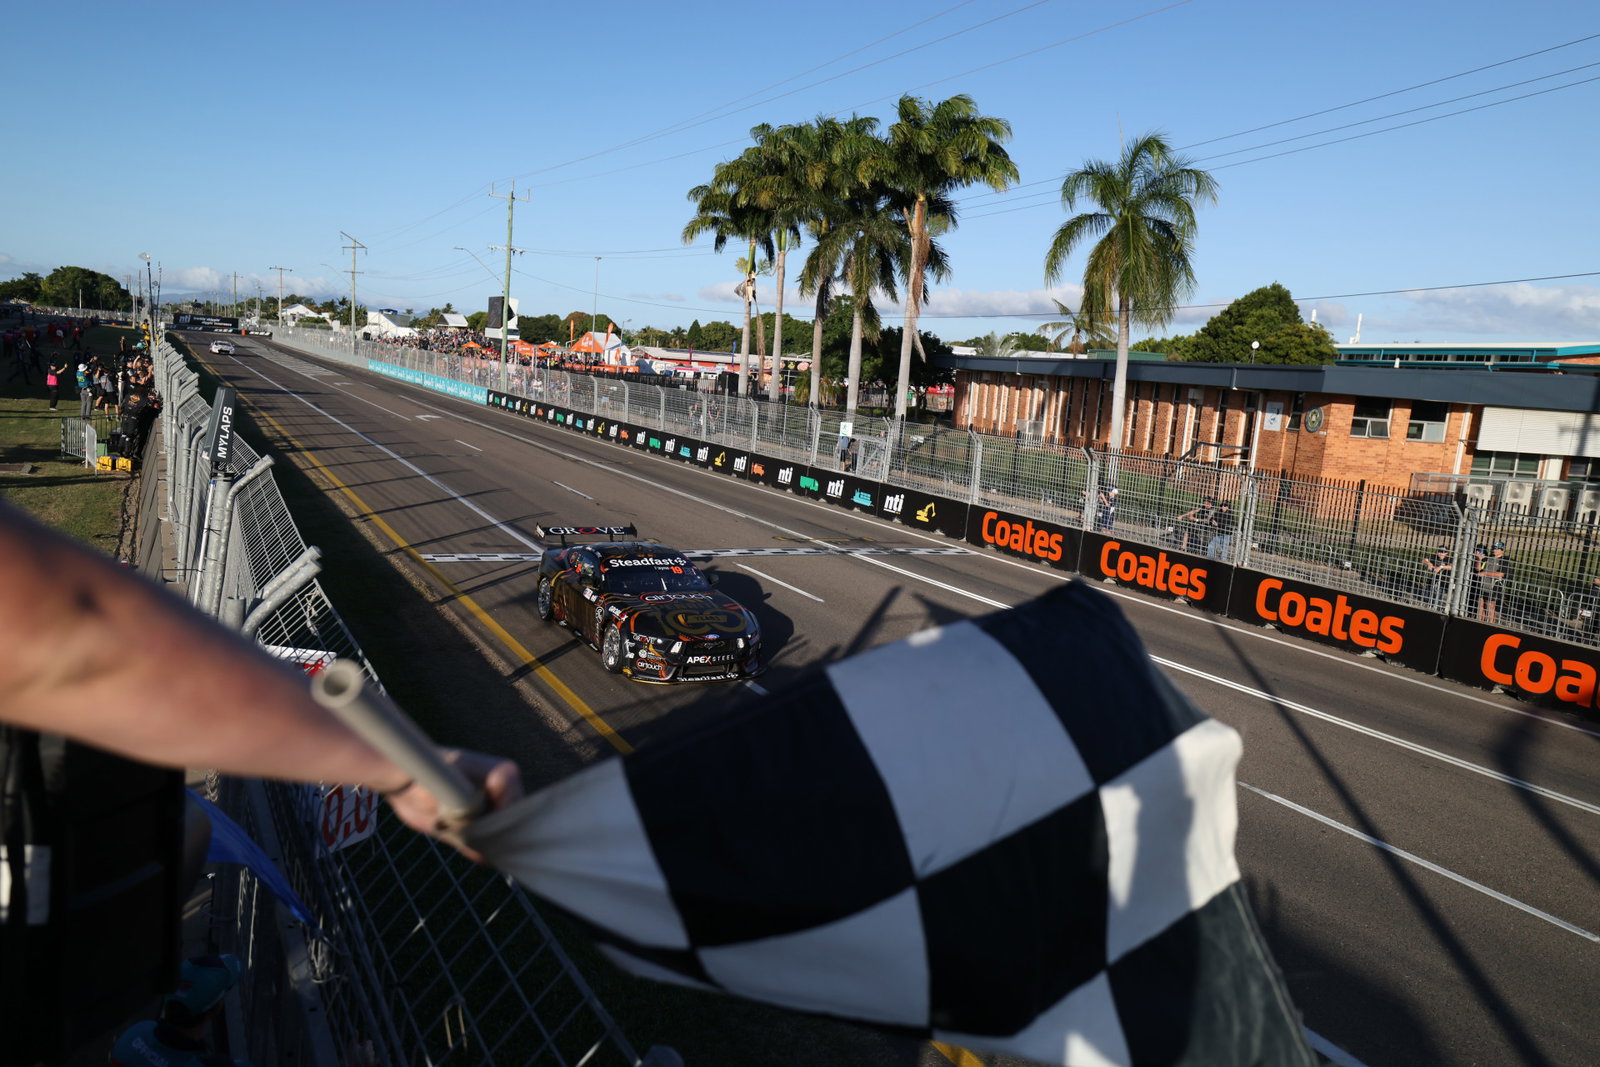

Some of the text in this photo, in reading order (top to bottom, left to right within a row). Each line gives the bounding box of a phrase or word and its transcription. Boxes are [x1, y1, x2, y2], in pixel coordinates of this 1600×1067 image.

[216, 406, 232, 459] MYLAPS
[665, 438, 675, 453] nti
[697, 446, 708, 462] nti
[733, 456, 746, 472] nti
[778, 467, 793, 484] nti
[826, 479, 843, 498] nti
[883, 493, 904, 514] nti
[549, 526, 624, 535] GROVE
[981, 511, 1063, 562] Coates
[609, 557, 673, 567] Steadfast
[1100, 540, 1208, 601] Coates
[1255, 578, 1405, 654] Coates
[637, 661, 662, 670] airtouch
[686, 655, 712, 664] APEX
[1481, 633, 1600, 710] Coa
